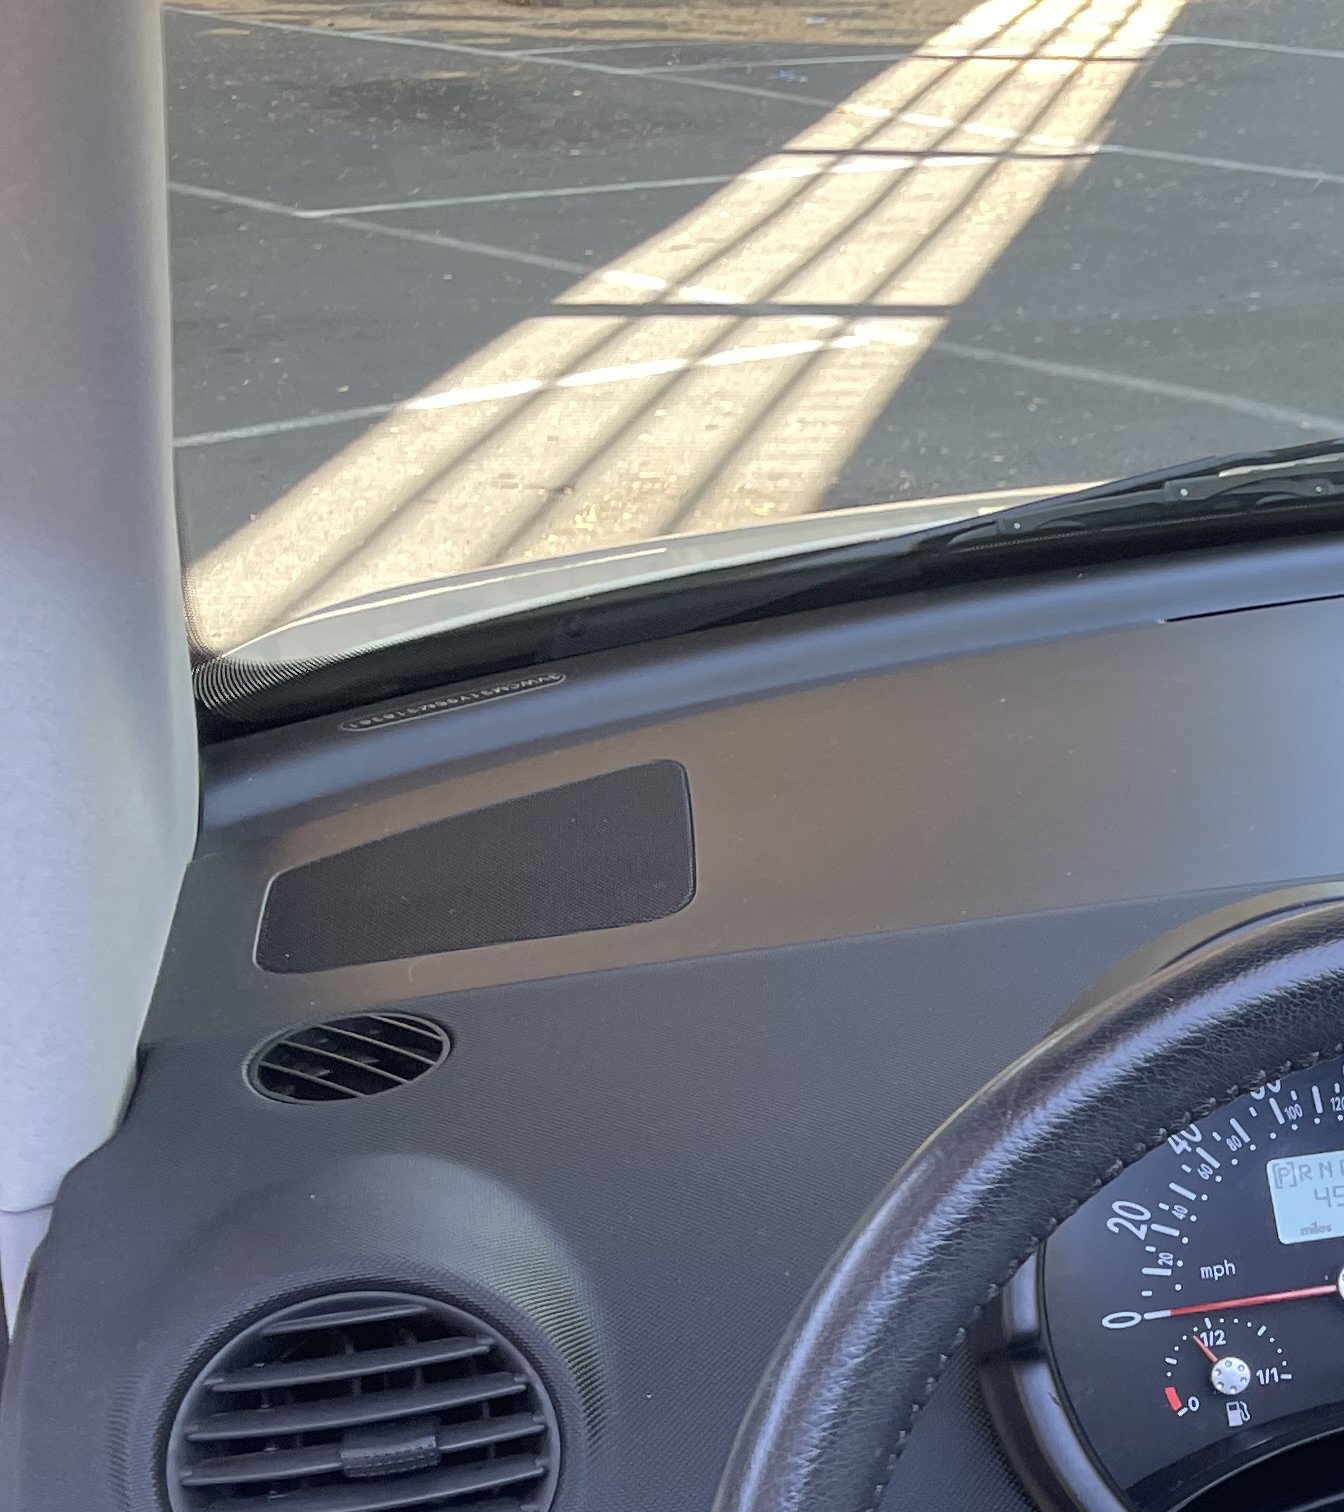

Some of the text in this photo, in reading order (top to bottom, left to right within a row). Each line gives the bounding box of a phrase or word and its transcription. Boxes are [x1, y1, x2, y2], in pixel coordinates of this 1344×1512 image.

[1284, 1103, 1303, 1121] 100
[1226, 1134, 1243, 1152] 80
[1197, 1163, 1213, 1180] 60
[1106, 1200, 1151, 1241] 20
[1171, 1204, 1189, 1220] 40
[1157, 1252, 1174, 1267] 20
[1200, 1259, 1236, 1281] mph
[1101, 1311, 1142, 1329] 0
[1200, 1330, 1227, 1347] 1/2
[1256, 1368, 1280, 1385] 1/1
[1187, 1396, 1200, 1412] 0
